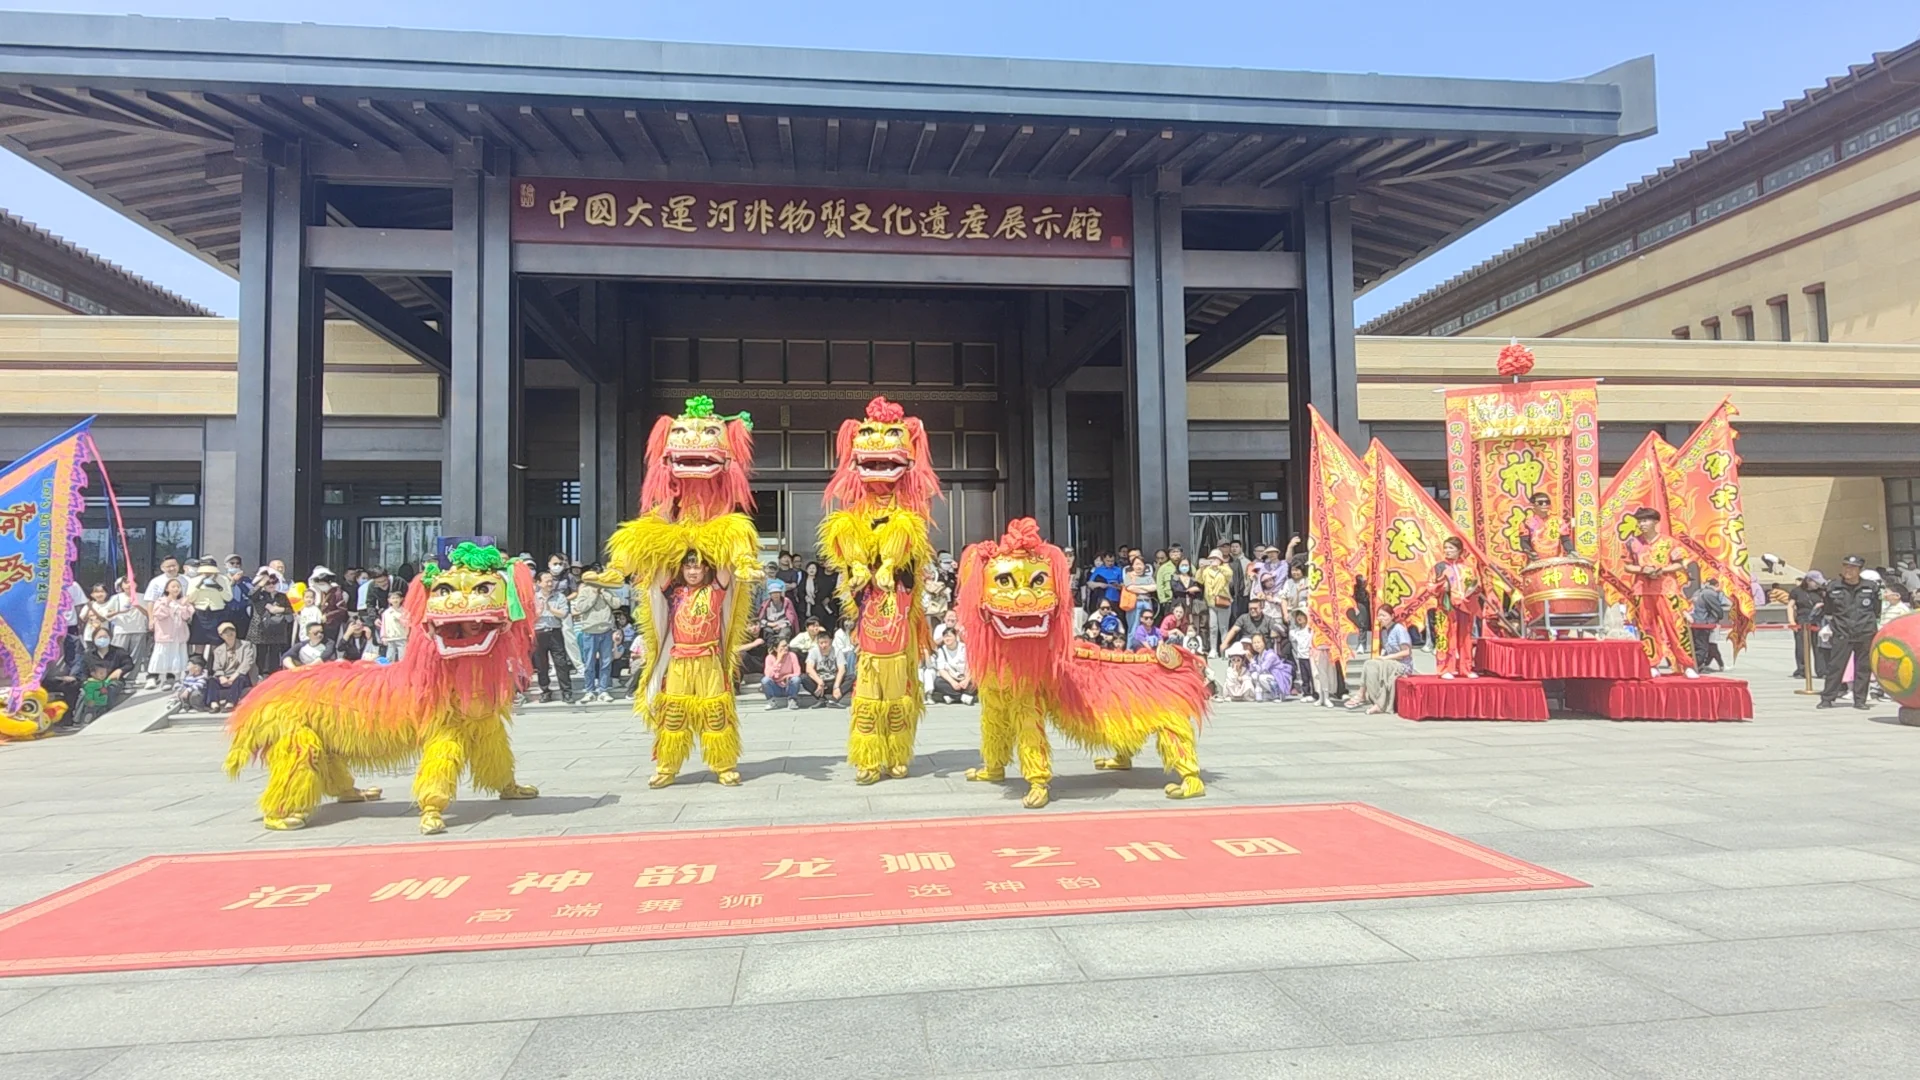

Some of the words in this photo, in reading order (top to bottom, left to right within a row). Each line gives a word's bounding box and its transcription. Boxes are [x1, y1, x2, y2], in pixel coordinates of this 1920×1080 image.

[221, 836, 1302, 911] 沧州神韵龙狮艺术团
